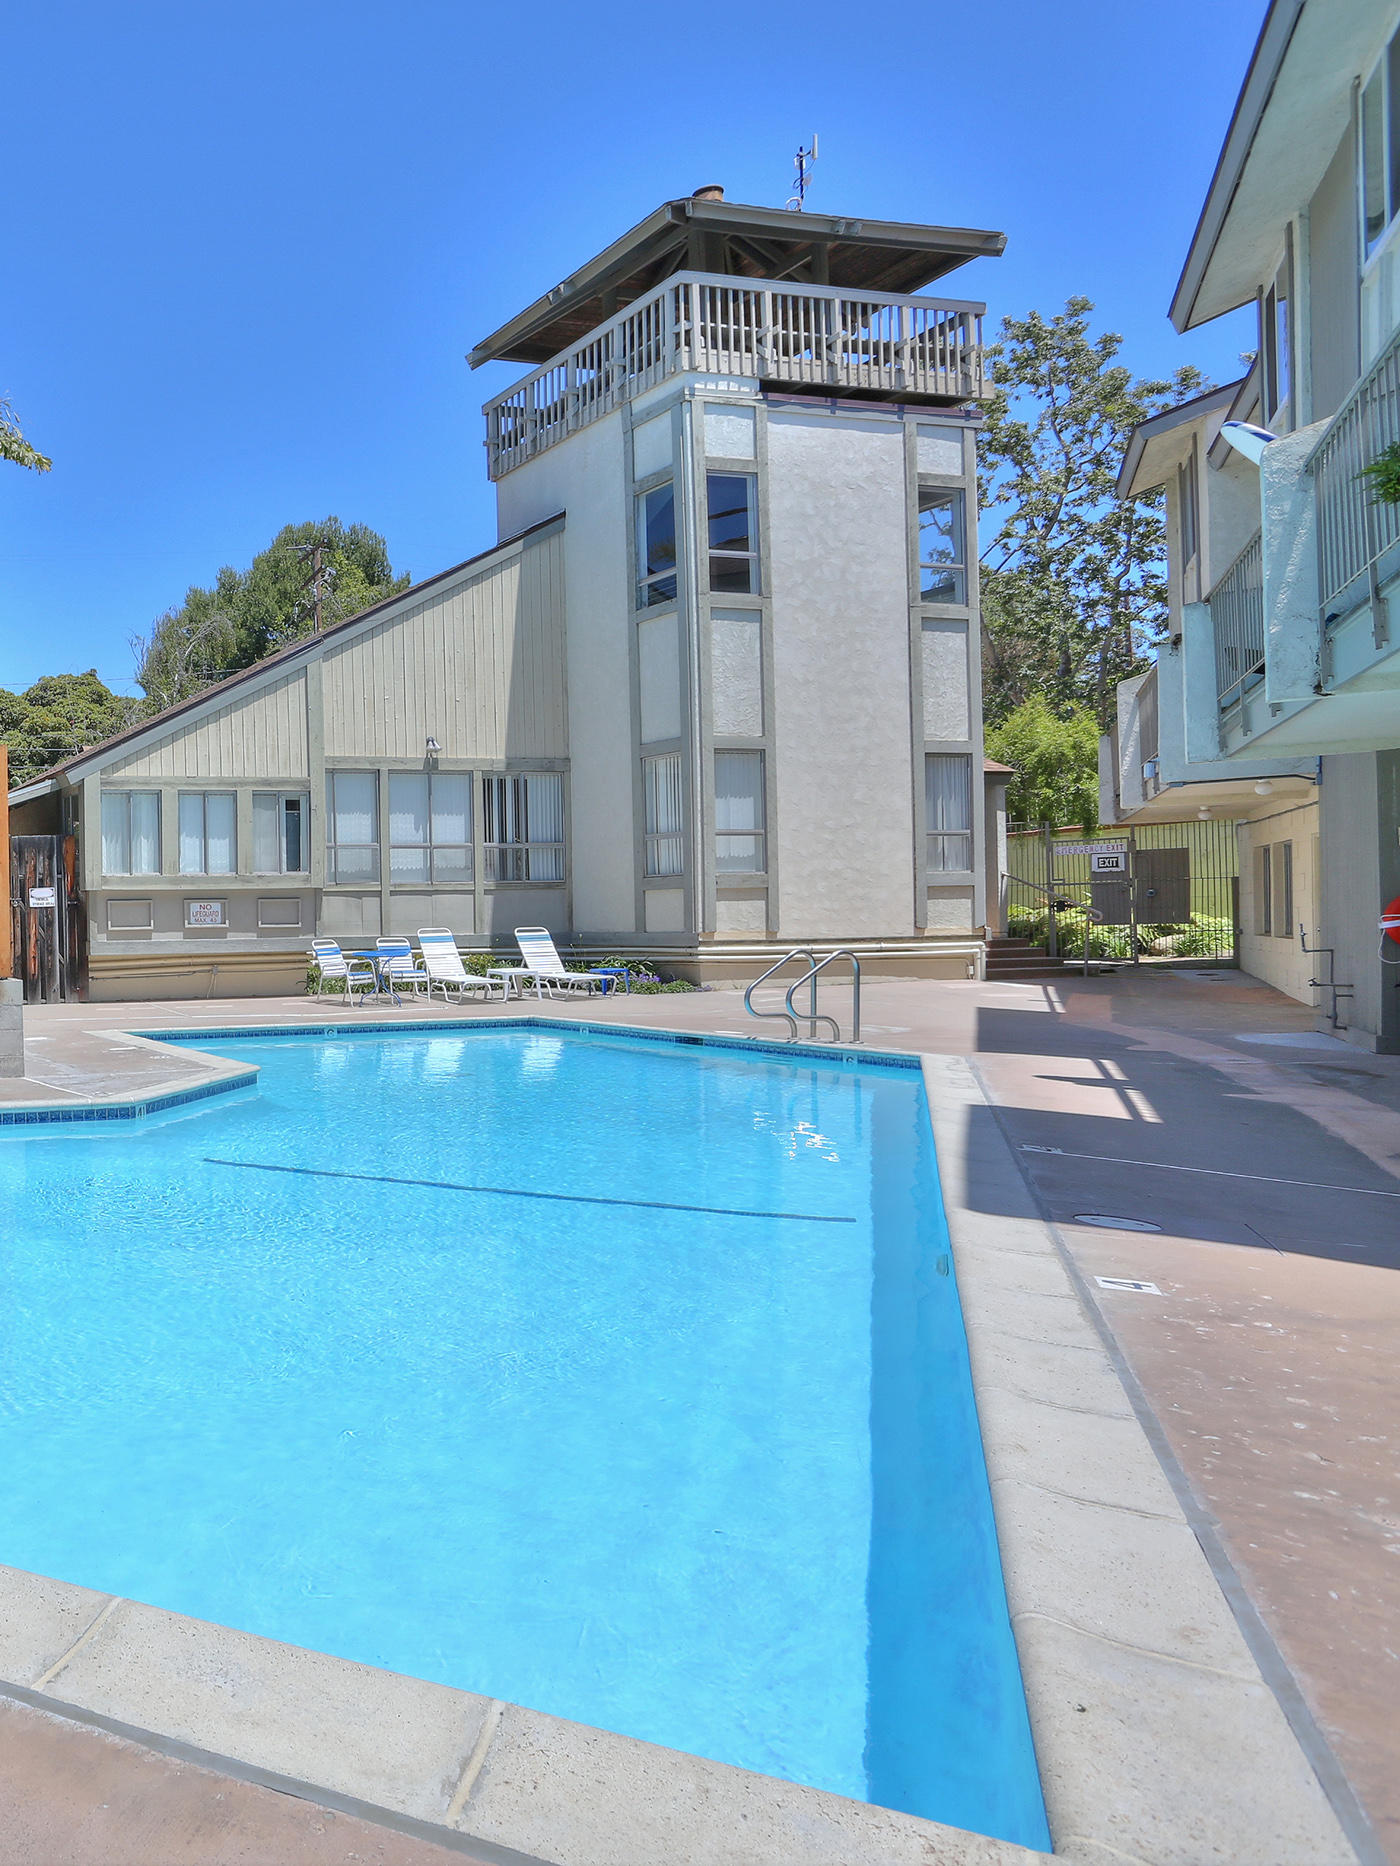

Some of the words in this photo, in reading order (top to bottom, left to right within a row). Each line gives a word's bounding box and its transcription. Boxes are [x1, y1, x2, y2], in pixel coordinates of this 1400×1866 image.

[1056, 845, 1103, 855] EMERGENCY
[1106, 843, 1124, 852] EXIT
[1098, 858, 1117, 867] EXIT
